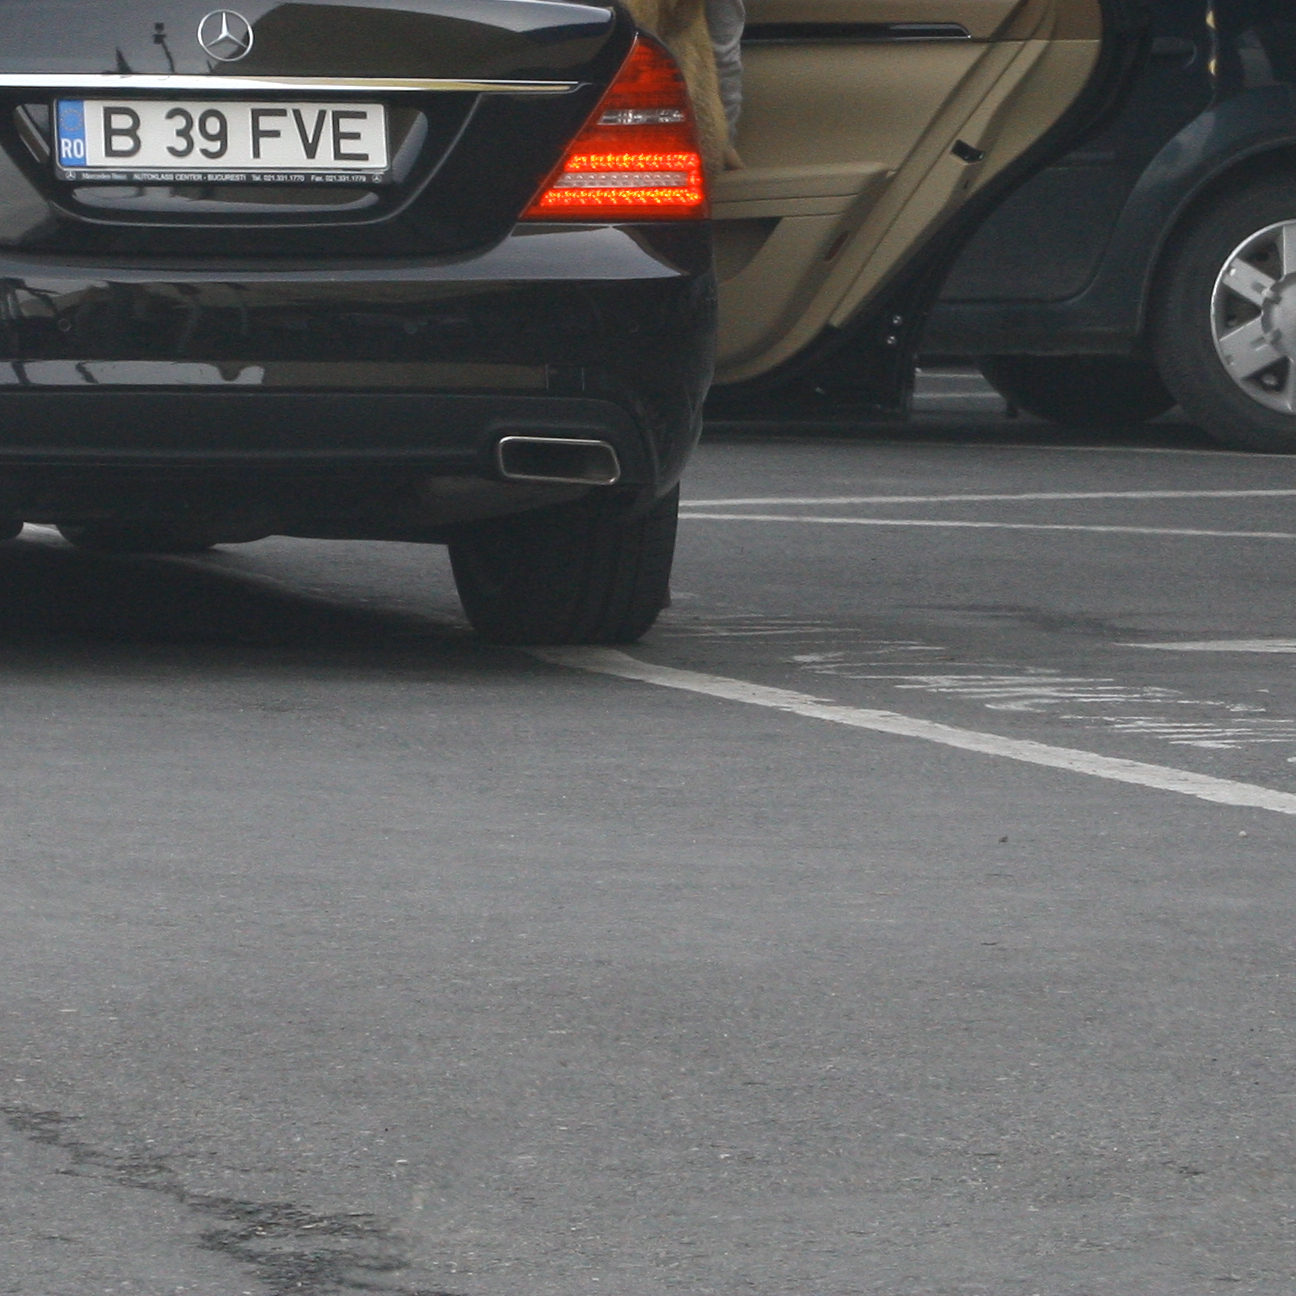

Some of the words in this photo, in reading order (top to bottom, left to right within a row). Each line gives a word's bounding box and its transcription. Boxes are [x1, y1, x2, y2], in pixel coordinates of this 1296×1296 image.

[61, 137, 85, 160] RO
[103, 106, 142, 158] B
[164, 108, 229, 160] 39
[251, 108, 371, 162] FVE
